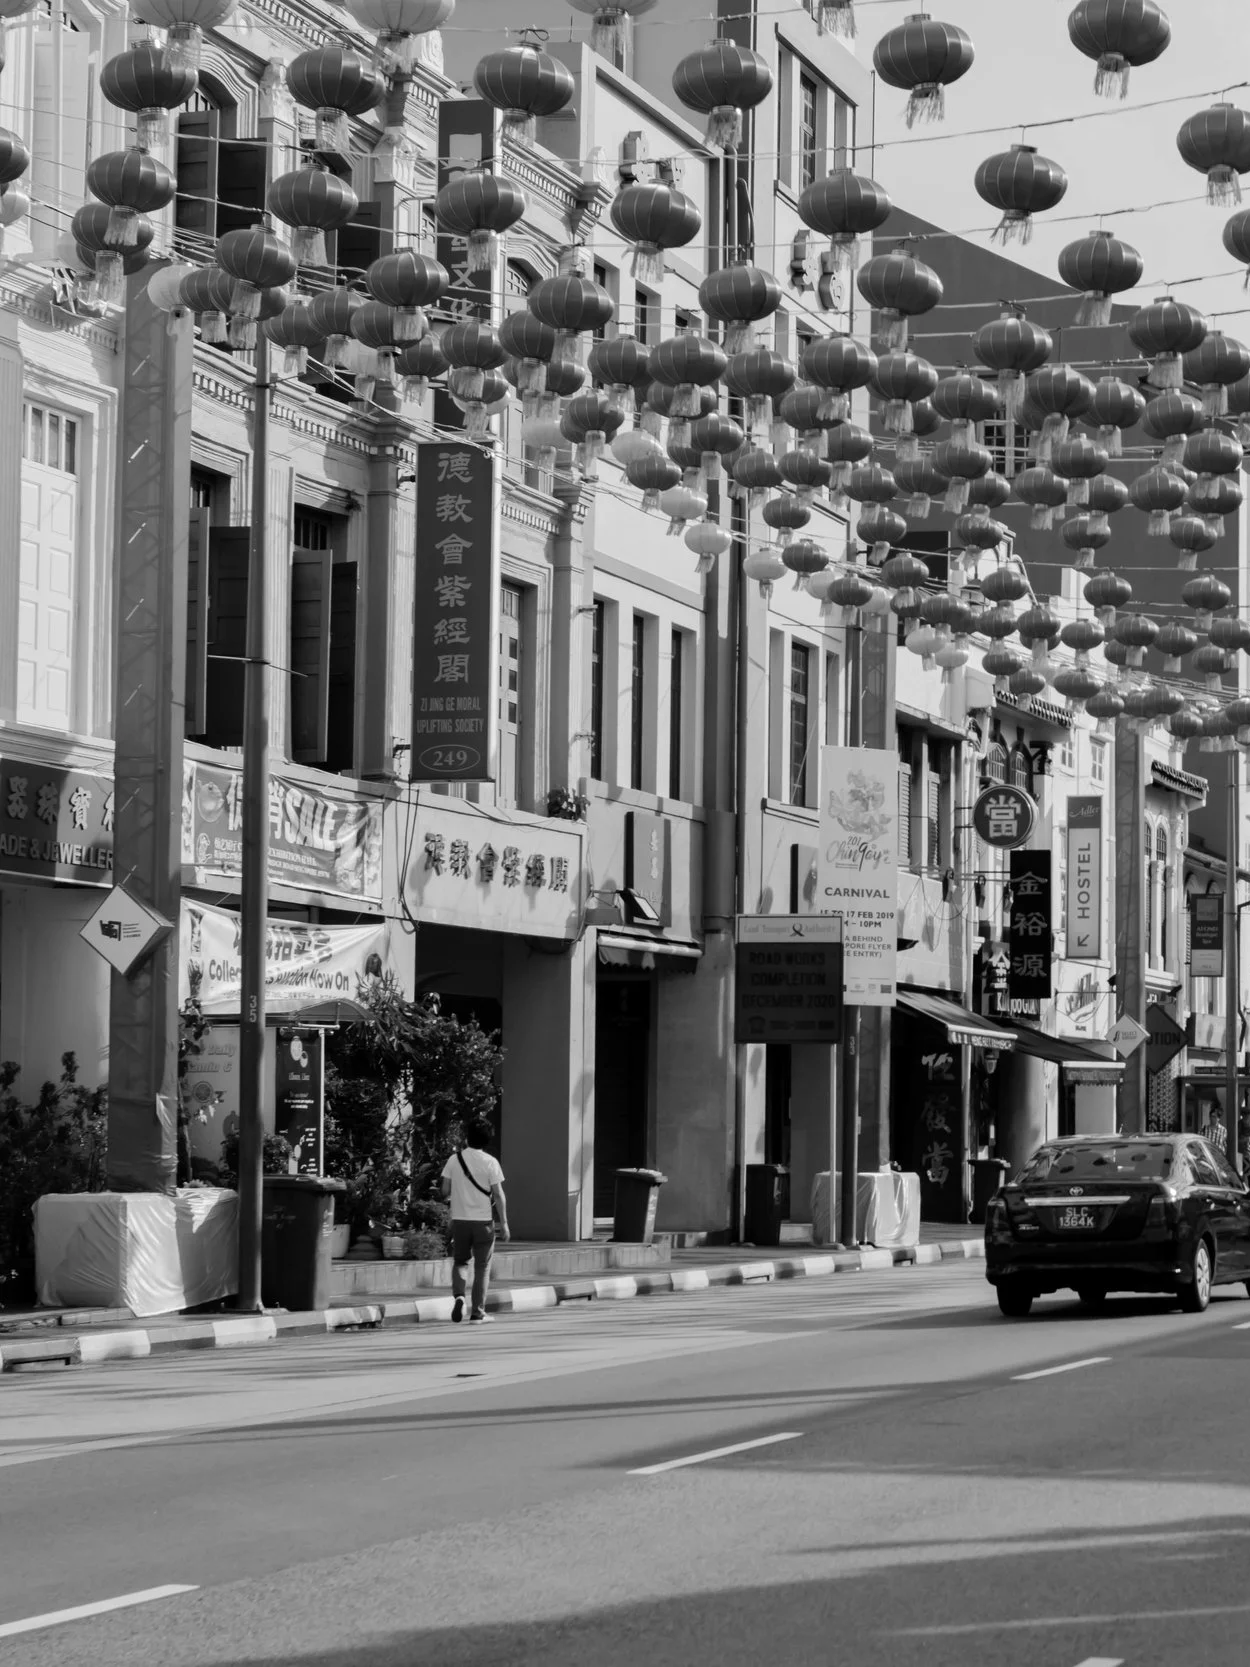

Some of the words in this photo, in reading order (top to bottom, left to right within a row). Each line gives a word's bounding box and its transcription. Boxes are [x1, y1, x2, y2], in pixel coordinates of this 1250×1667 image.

[433, 451, 474, 684] 德教會紫經閣
[420, 697, 429, 712] ZI
[429, 697, 445, 712] JING
[446, 697, 456, 711] GE
[457, 696, 482, 711] MORAL
[417, 718, 453, 734] UPLIFTING
[455, 717, 484, 733] SOCIETY
[433, 751, 468, 767] 249
[285, 788, 338, 852] SALE
[984, 796, 1021, 838] 當
[31, 838, 40, 861] &
[1077, 843, 1090, 919] HOSTEL
[824, 887, 890, 899] CARNIVAL
[857, 911, 874, 919] FEB
[859, 920, 882, 928] 10PM
[852, 935, 883, 943] BEHIND
[867, 943, 892, 951] FLYER
[309, 969, 334, 989] Now
[335, 971, 350, 991] On
[750, 972, 826, 986] COMPLETION
[1066, 1207, 1089, 1217] SLC
